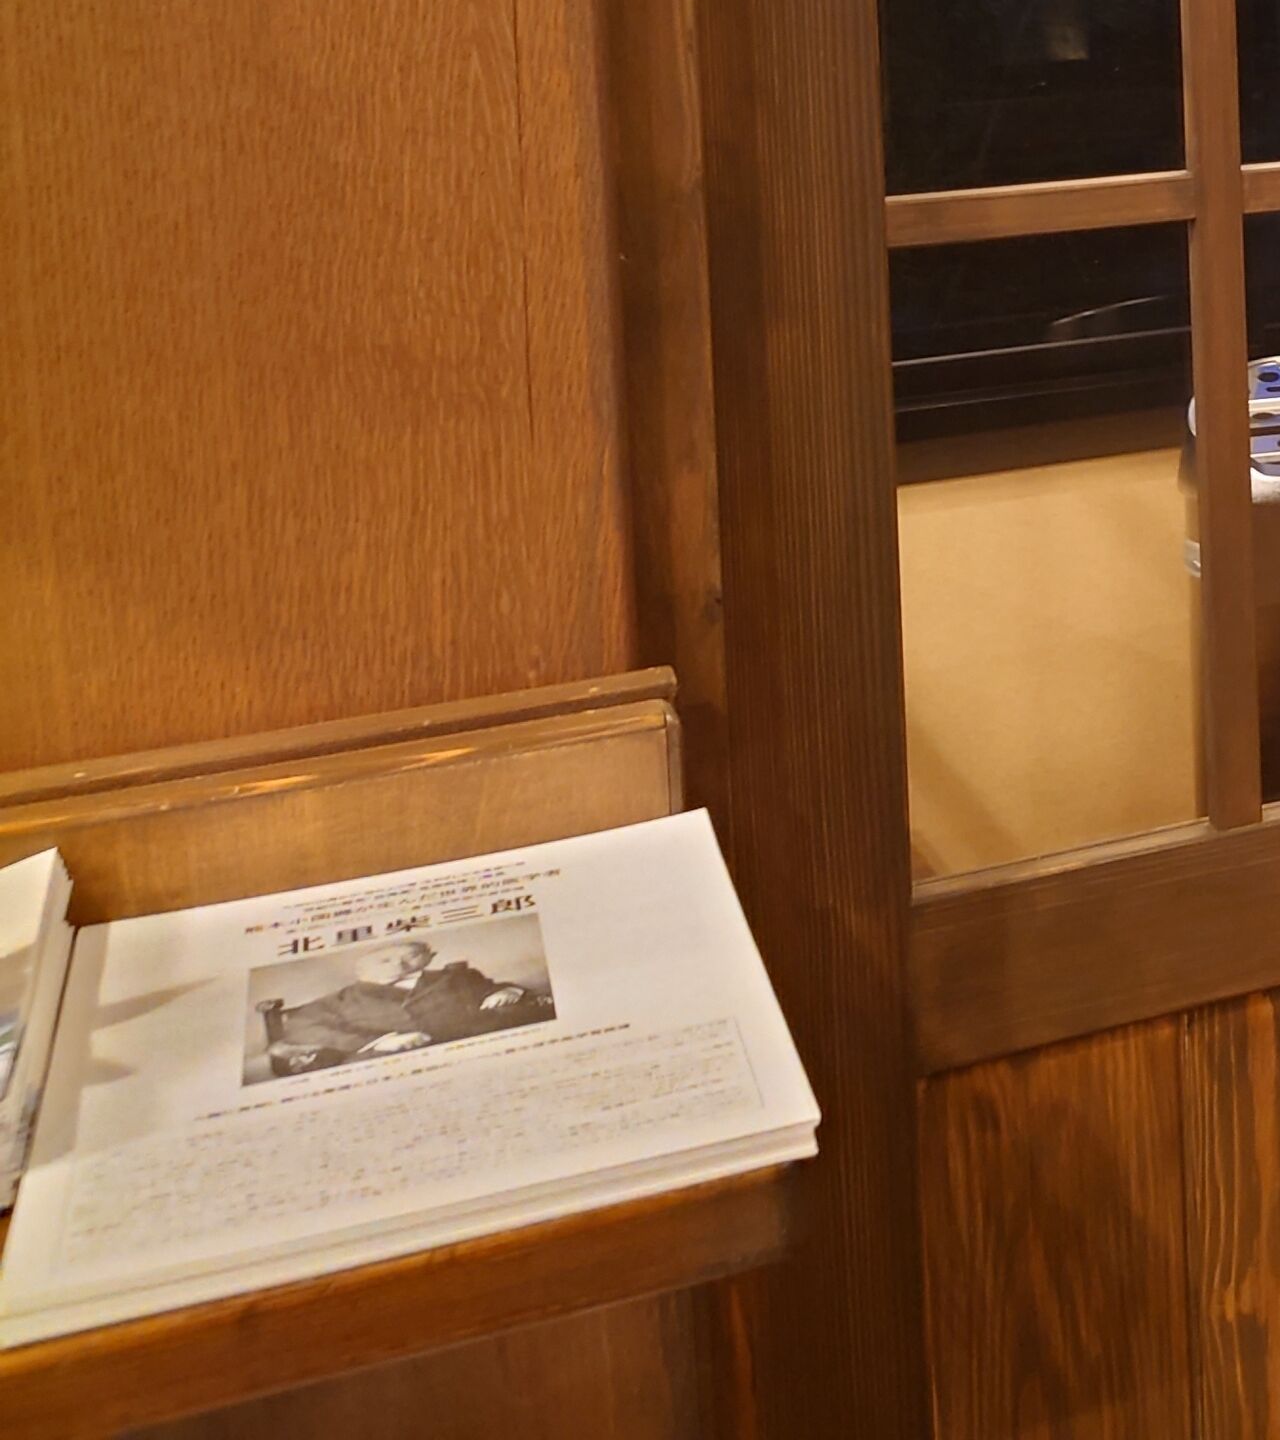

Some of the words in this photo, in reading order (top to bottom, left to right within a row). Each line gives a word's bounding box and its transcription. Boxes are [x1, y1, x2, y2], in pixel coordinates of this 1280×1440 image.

[276, 893, 537, 957] 北里柴三郎
